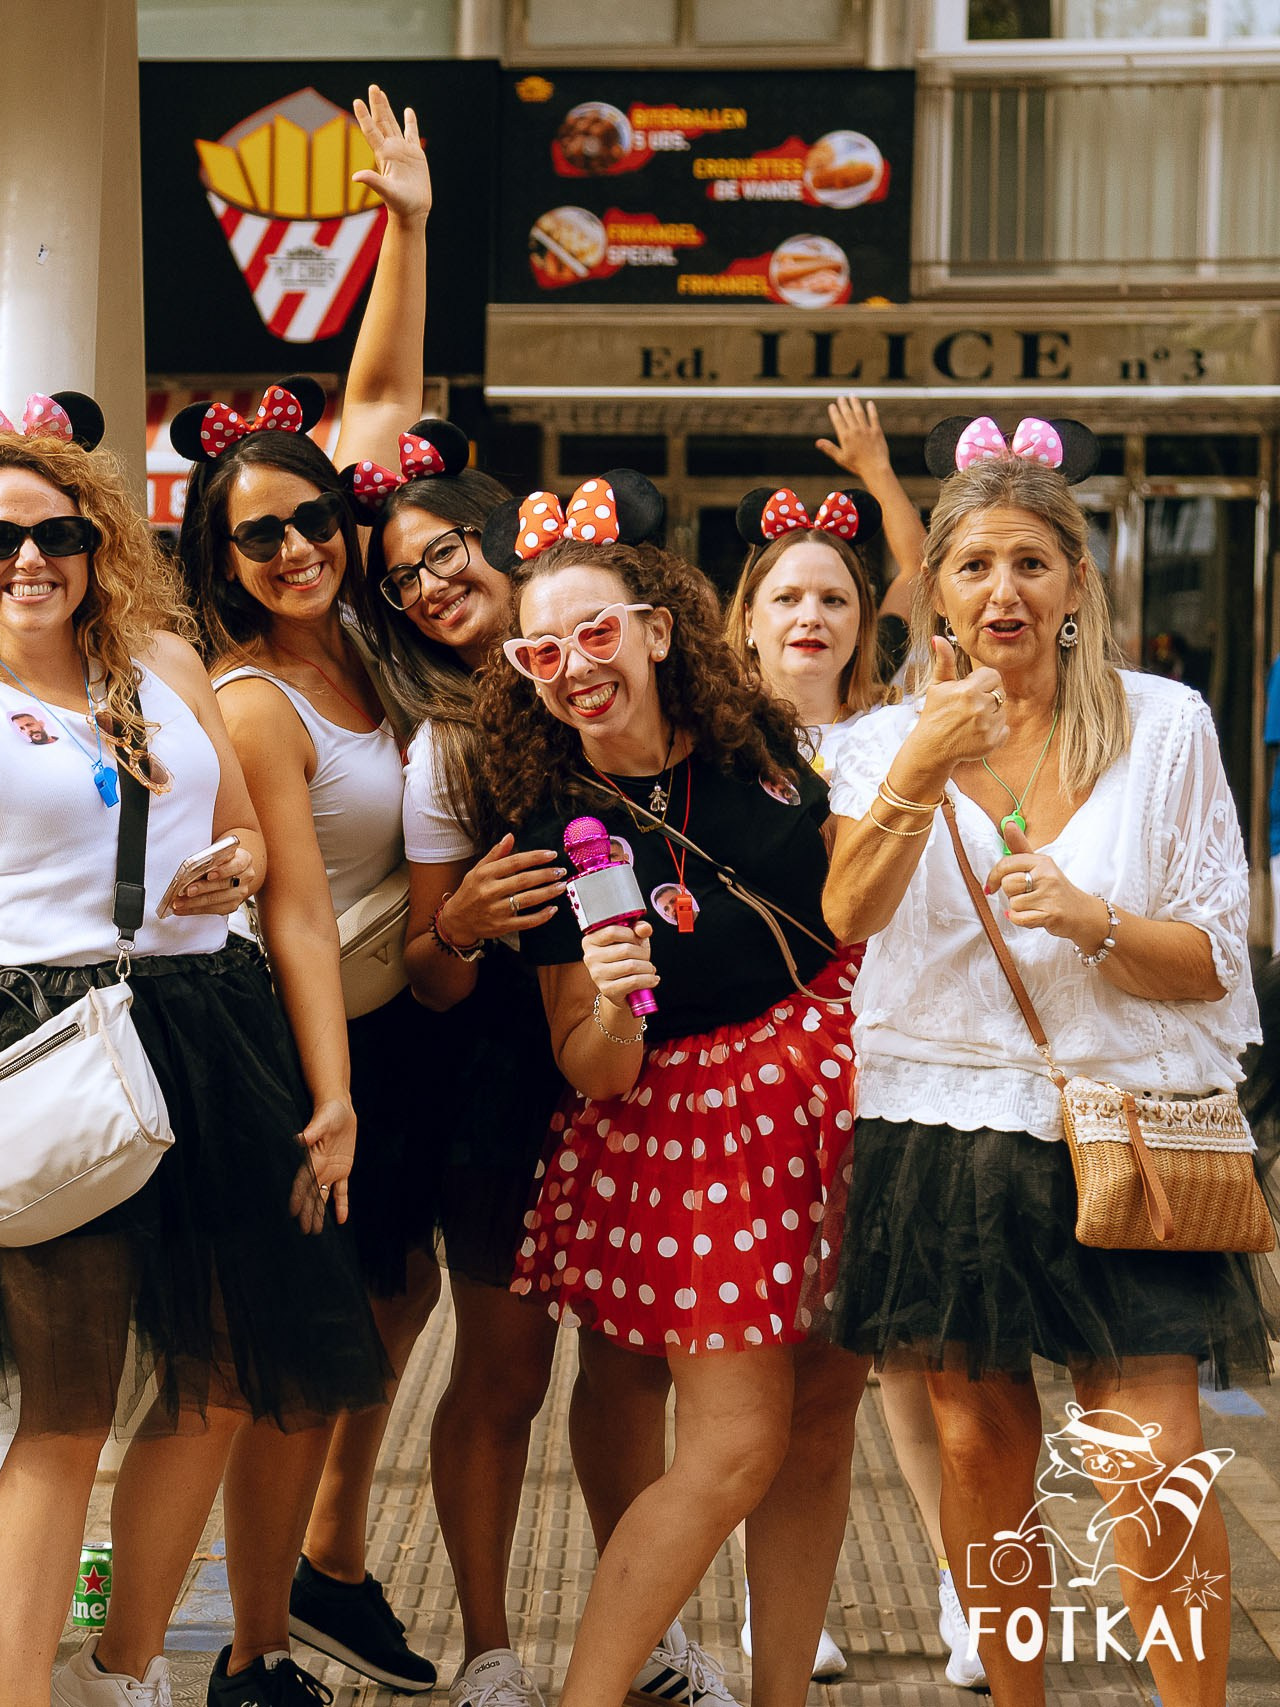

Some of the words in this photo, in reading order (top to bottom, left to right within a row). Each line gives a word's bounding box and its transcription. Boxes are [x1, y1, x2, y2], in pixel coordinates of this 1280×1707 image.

[713, 180, 740, 201] DE
[639, 346, 719, 381] Ed.
[753, 328, 1073, 383] ILICE
[1182, 348, 1207, 382] 3
[73, 1594, 111, 1620] ine
[474, 1660, 501, 1675] adidas
